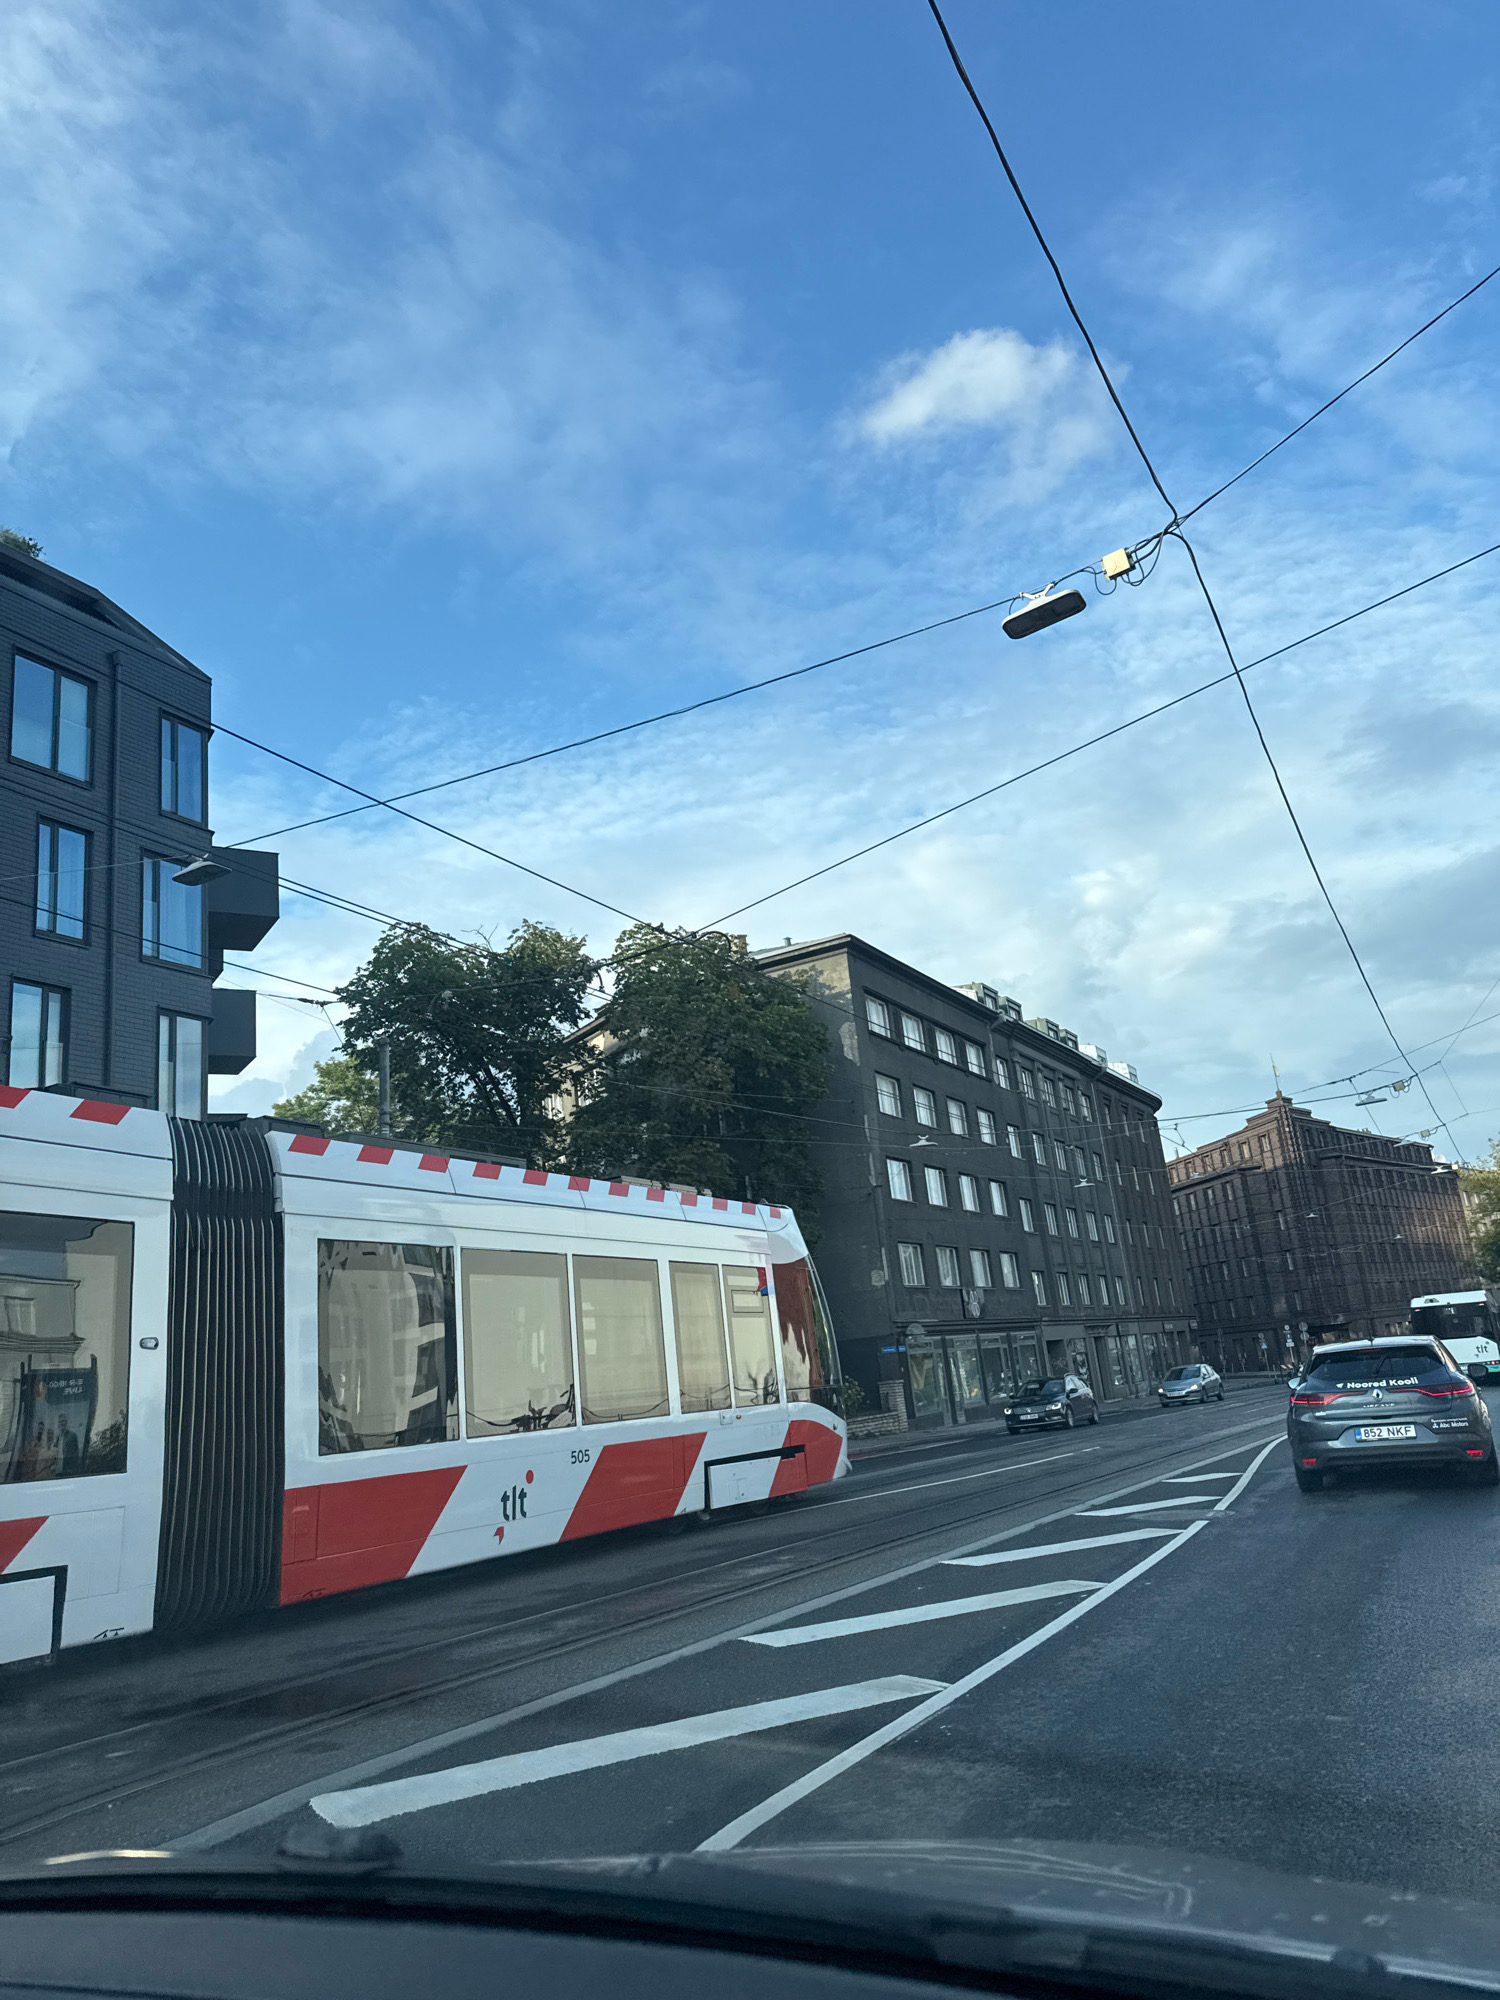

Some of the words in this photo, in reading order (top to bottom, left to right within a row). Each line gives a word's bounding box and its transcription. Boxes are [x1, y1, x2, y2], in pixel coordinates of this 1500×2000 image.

[1476, 1345, 1488, 1353] tlt
[1347, 1380, 1387, 1389] Noored
[1363, 1428, 1383, 1437] 852
[1386, 1425, 1411, 1436] NKF
[571, 1449, 590, 1464] 505
[501, 1485, 527, 1521] tlt
